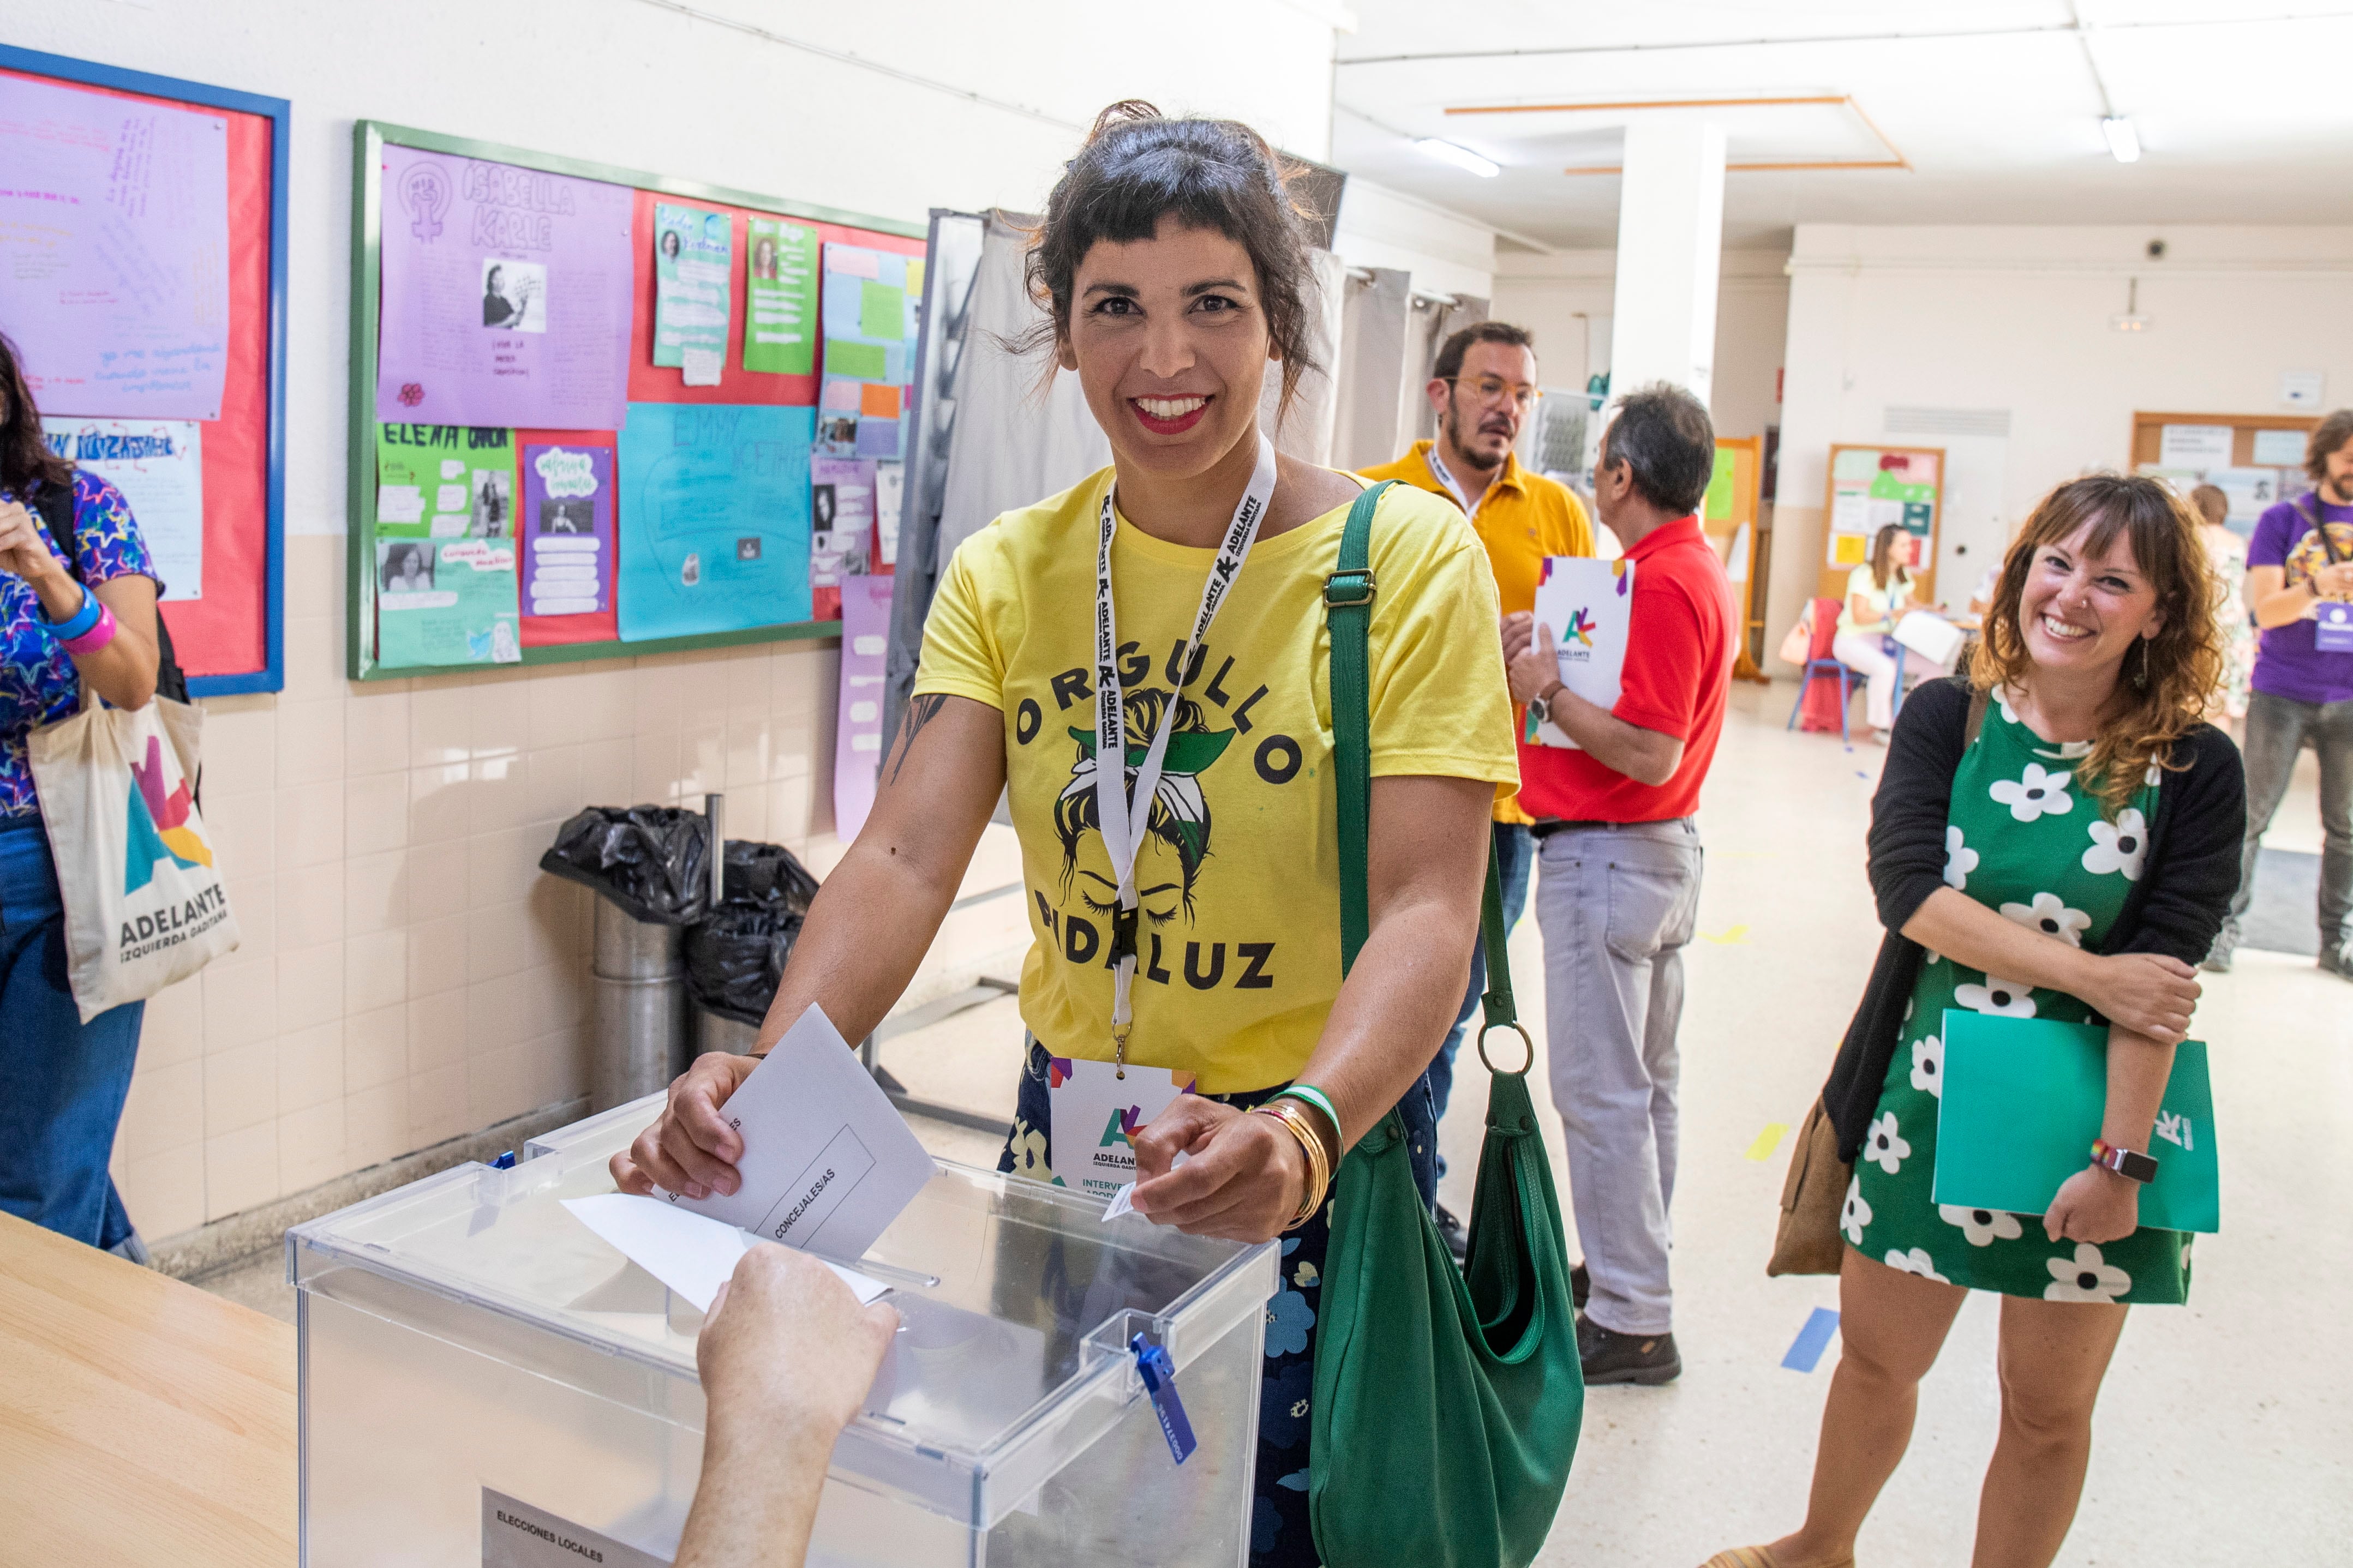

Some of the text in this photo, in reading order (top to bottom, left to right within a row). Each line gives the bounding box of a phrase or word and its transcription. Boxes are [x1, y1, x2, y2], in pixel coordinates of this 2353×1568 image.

[463, 163, 575, 217] ISABELLA
[471, 205, 552, 253] KARLE
[1226, 495, 1258, 555] ADELANTE
[1101, 602, 1110, 662] ADELANTE
[1195, 578, 1222, 644] ADELANTE
[1016, 639, 1303, 785] ORGULLO
[1107, 690, 1118, 749] ADELANTE
[120, 882, 225, 949] ADELANTE
[120, 909, 227, 964] IZQUIERDA GADITANA
[1083, 1179, 1125, 1191] INTERVE
[1093, 1153, 1136, 1166] ADELAN
[774, 1168, 836, 1240] CONCEJALES/AS
[497, 1510, 603, 1563] ELECCIONES LOCALES
